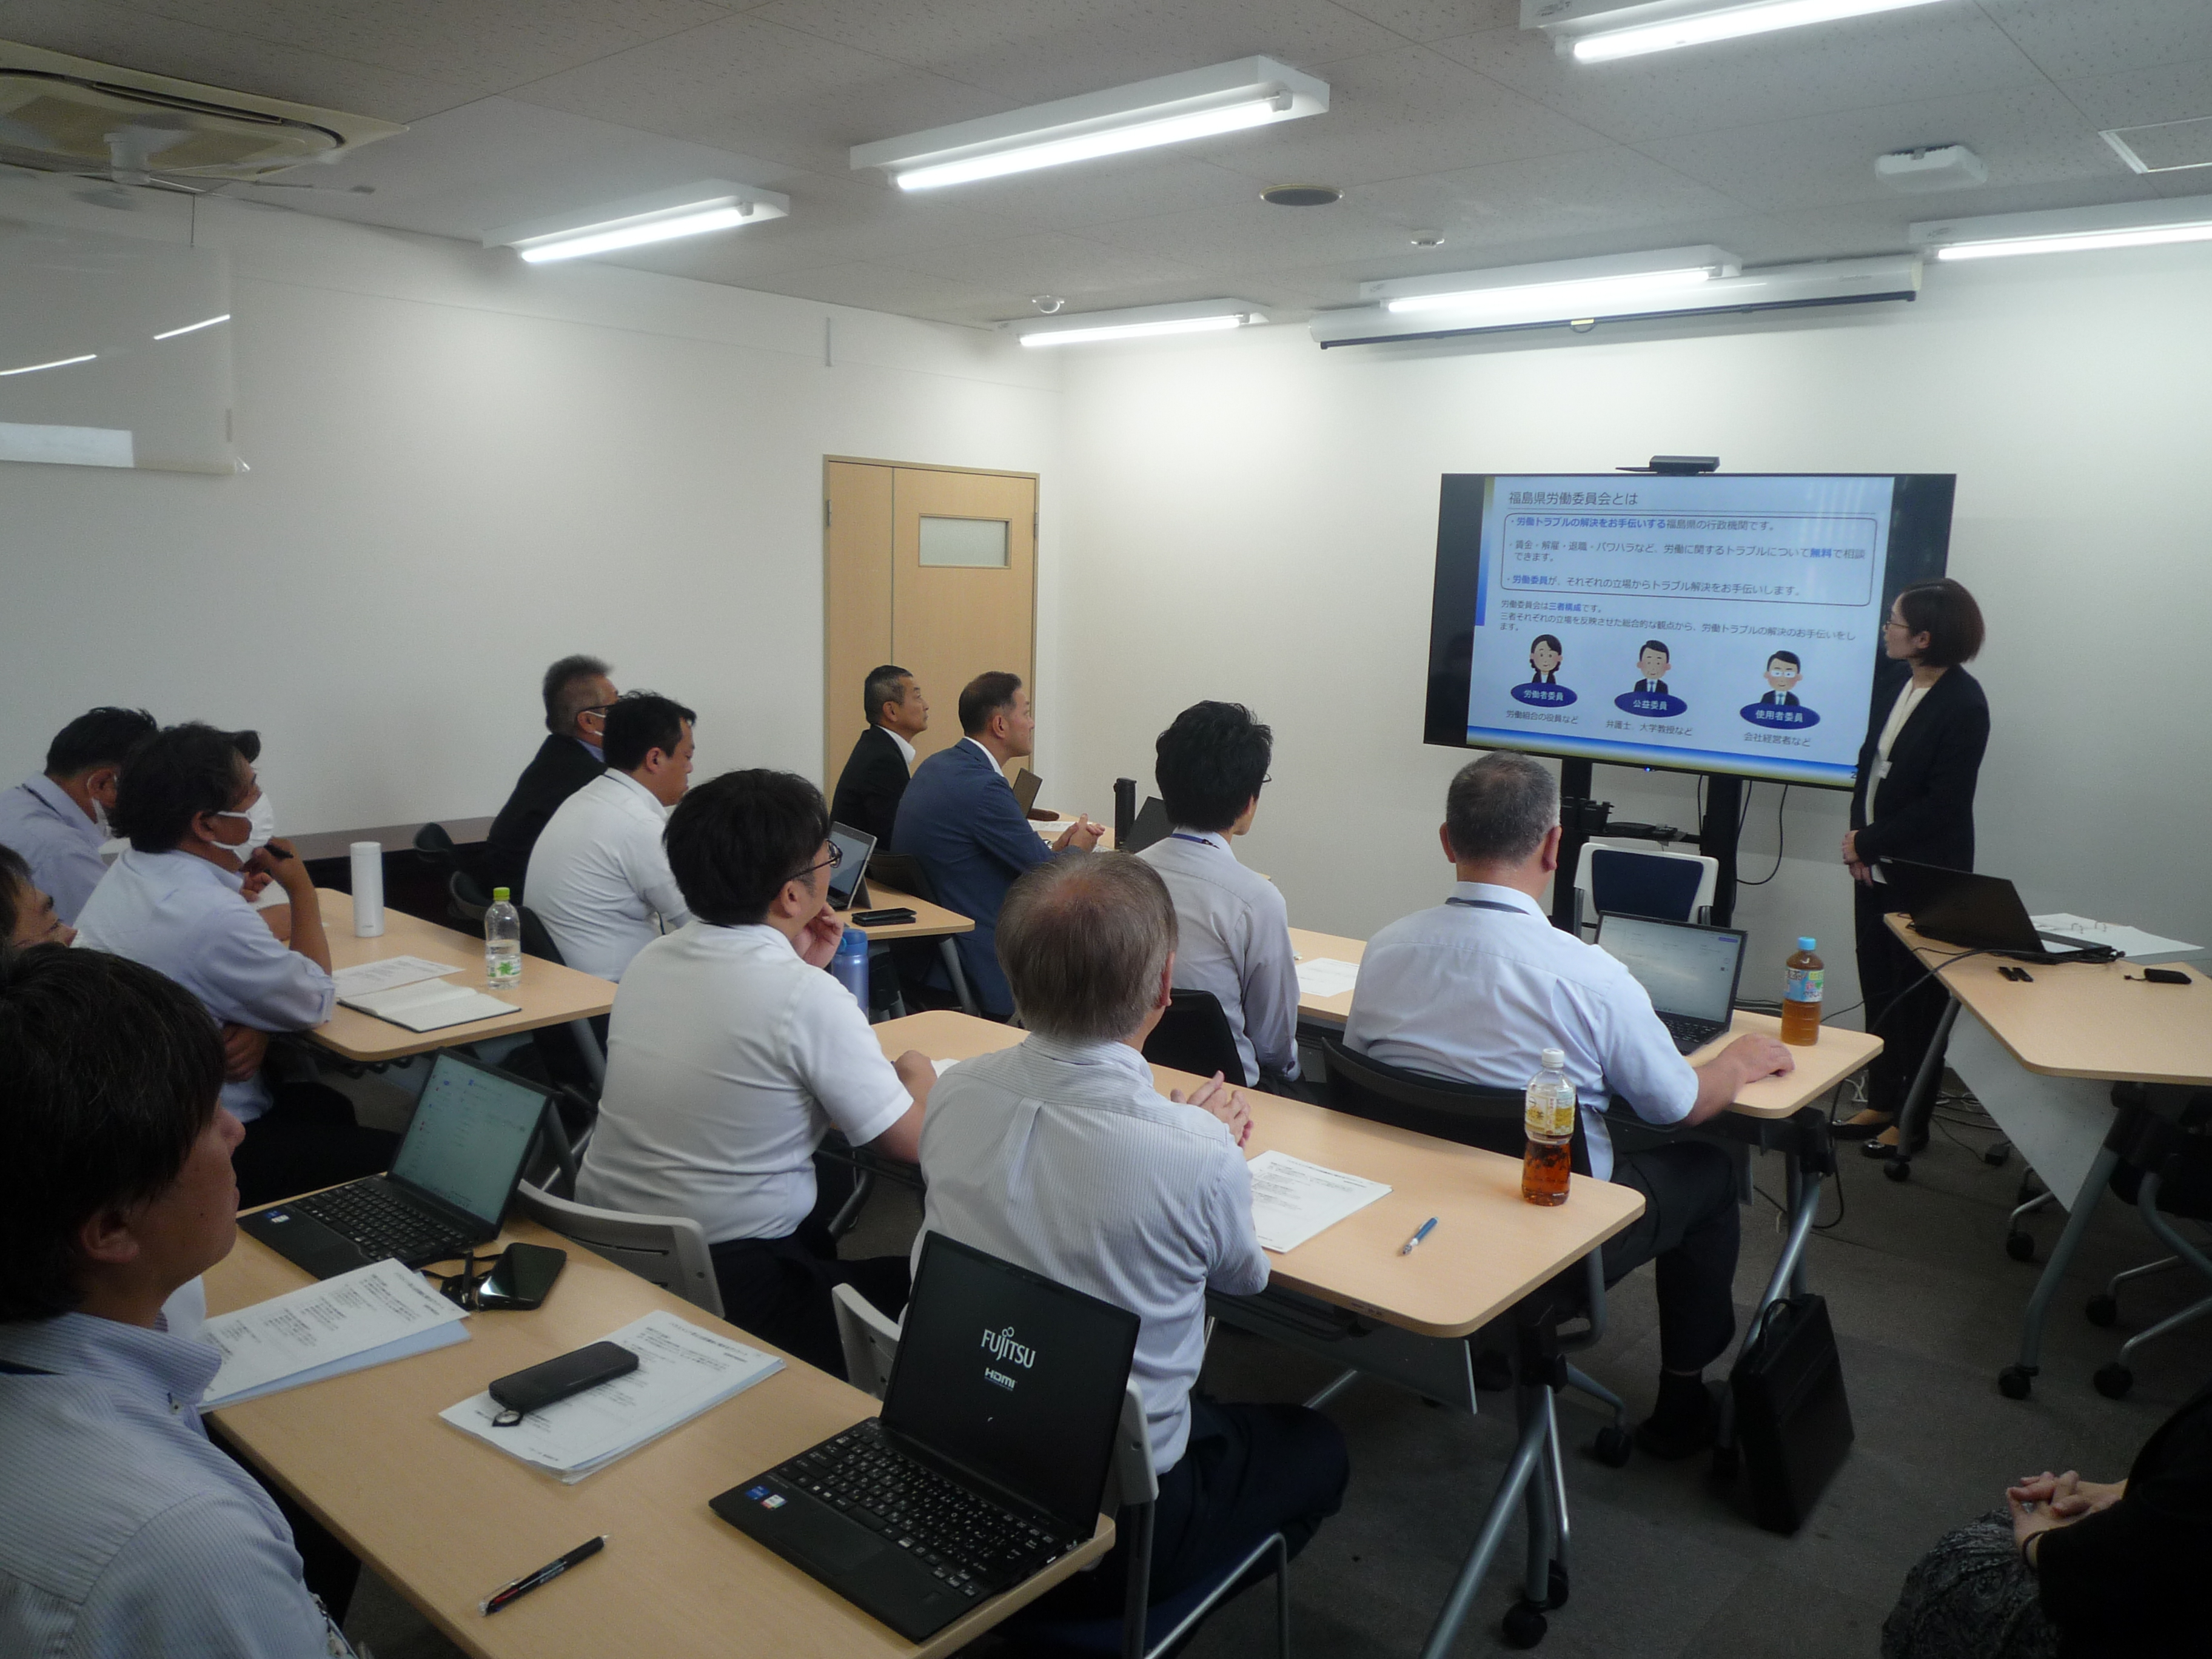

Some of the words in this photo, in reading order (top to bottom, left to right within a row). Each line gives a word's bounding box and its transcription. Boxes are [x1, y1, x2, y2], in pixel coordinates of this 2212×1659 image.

[1509, 492, 1638, 506] 福島県労働委員会とは
[1524, 689, 1564, 702] 労働者委員
[1633, 699, 1667, 711] 公益委員
[1506, 710, 1579, 725] 労働組合の役員など
[1755, 709, 1803, 723] 使用者委員
[1744, 732, 1811, 747] 会社経営者など
[981, 1327, 1036, 1369] FUJITSU
[985, 1367, 1016, 1389] HDMI
